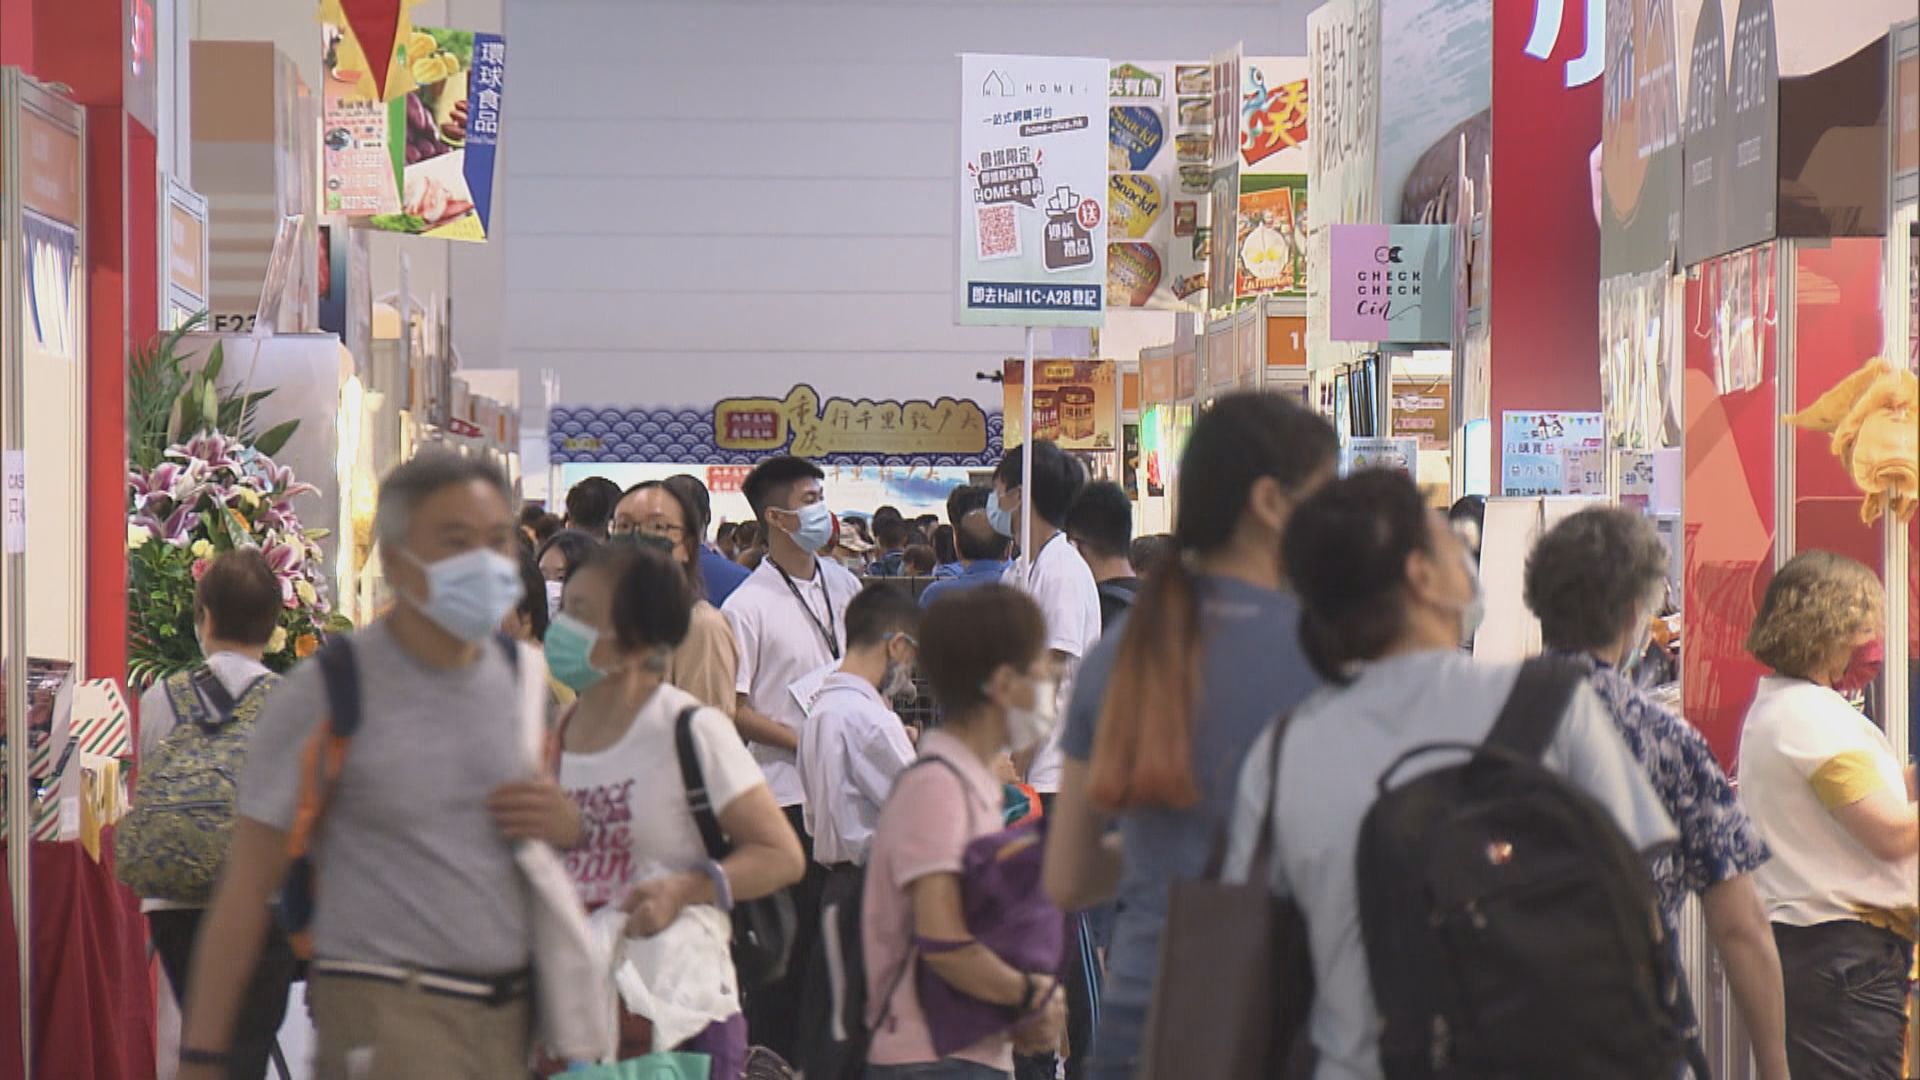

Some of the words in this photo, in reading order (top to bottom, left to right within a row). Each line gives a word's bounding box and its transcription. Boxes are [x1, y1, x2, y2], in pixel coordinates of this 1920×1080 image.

[474, 42, 505, 134] 環球食品
[1082, 202, 1099, 227] 送
[1357, 271, 1422, 282] CHECK
[1357, 285, 1422, 296] CHECK
